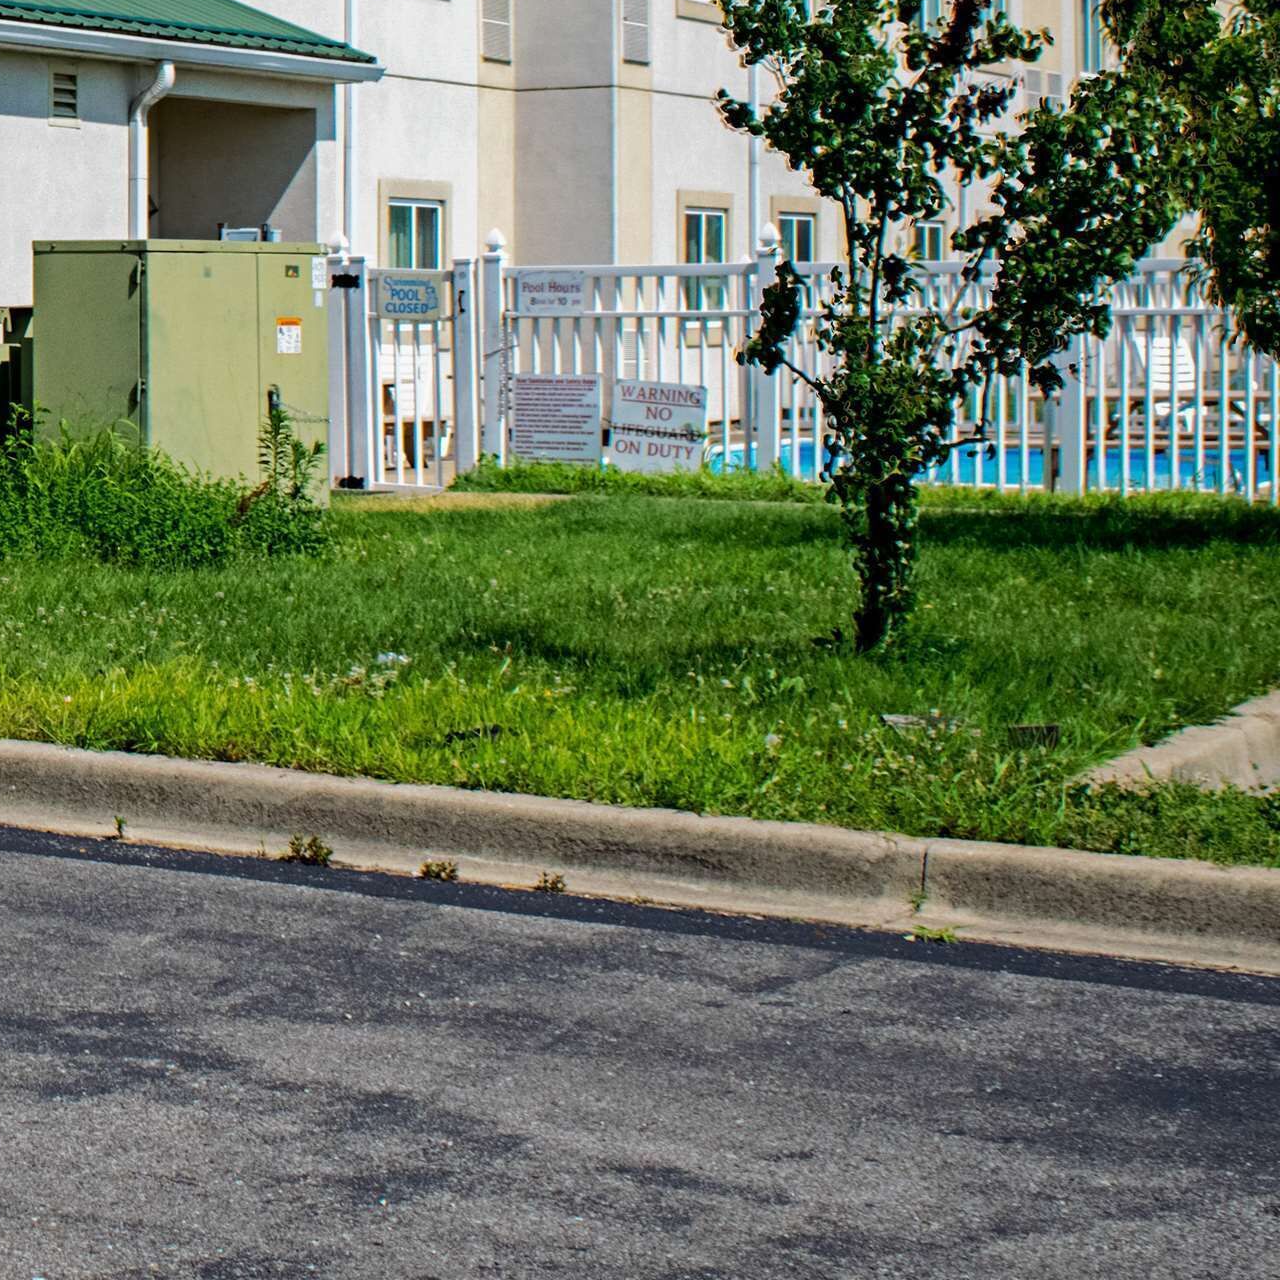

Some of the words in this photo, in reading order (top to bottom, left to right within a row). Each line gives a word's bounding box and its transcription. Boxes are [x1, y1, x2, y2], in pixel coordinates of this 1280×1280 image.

[522, 281, 544, 293] Pool
[548, 281, 581, 293] Hours
[391, 288, 421, 301] POOL
[384, 302, 429, 314] CLOSED
[621, 385, 701, 405] WARNING
[645, 406, 673, 421] NO
[615, 439, 641, 455] ON
[647, 442, 695, 459] DUTY
